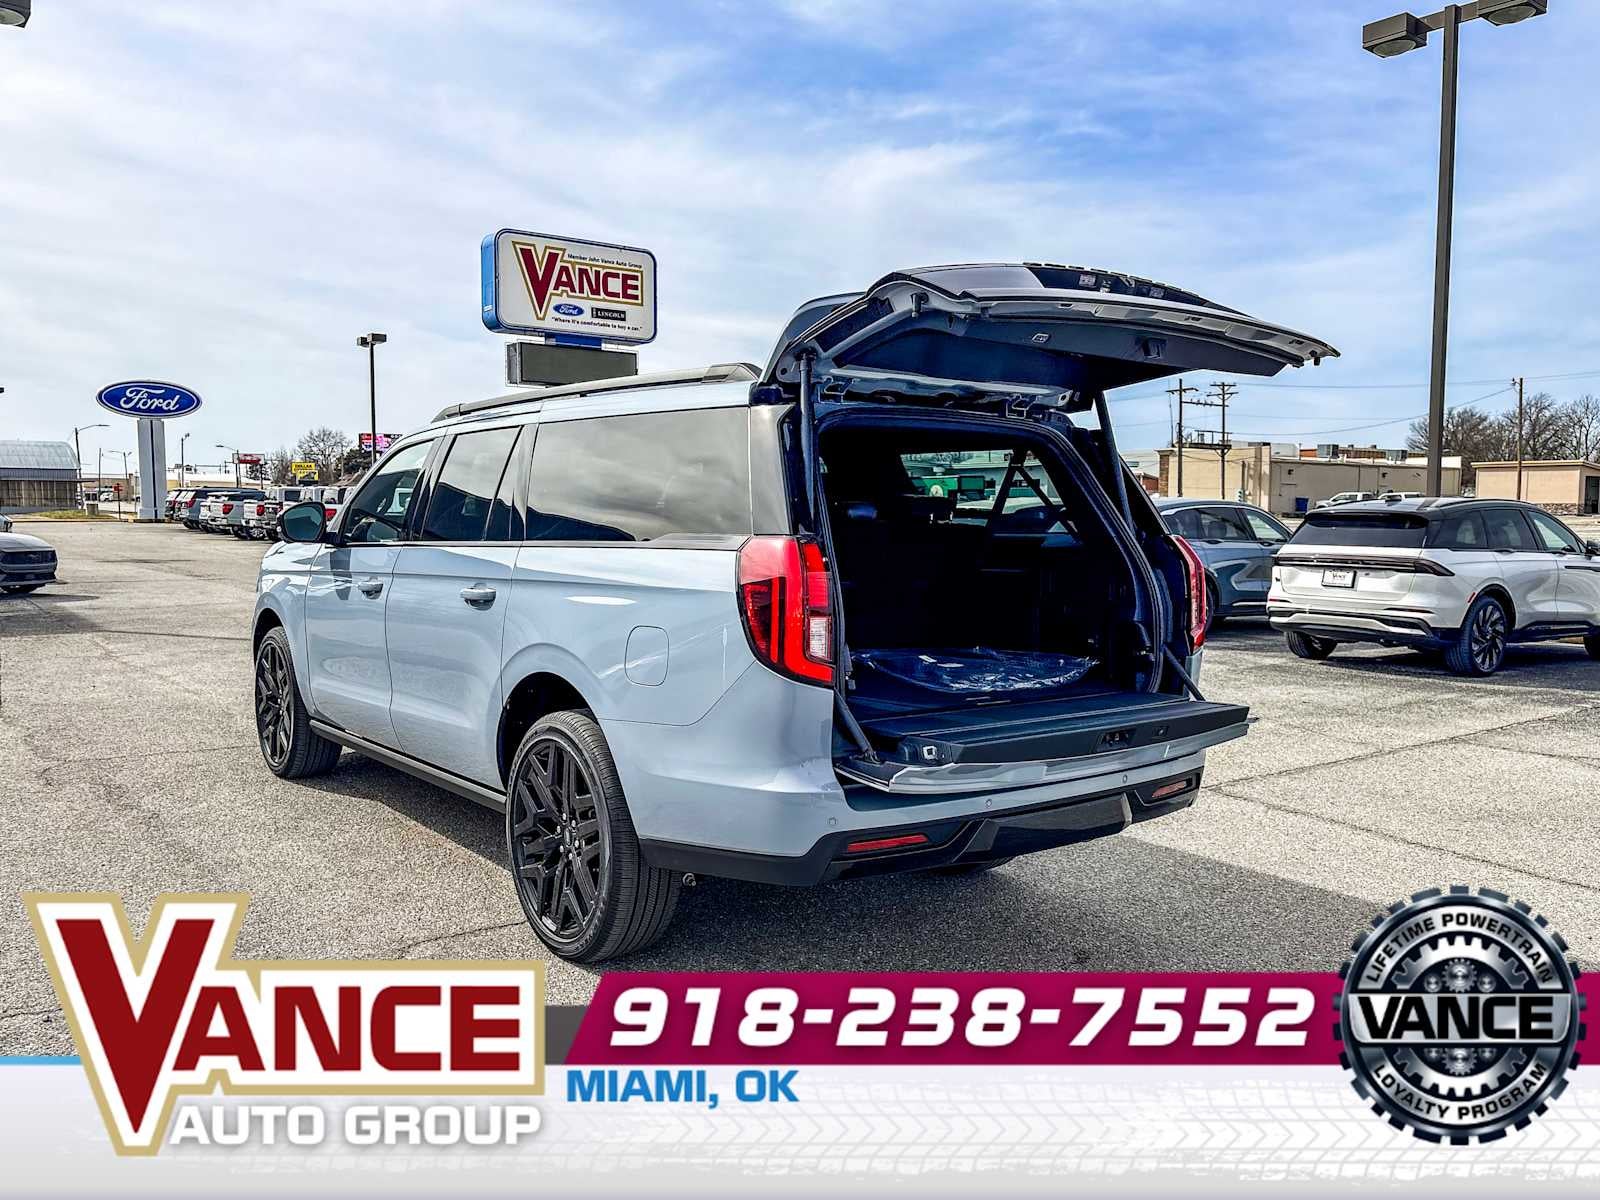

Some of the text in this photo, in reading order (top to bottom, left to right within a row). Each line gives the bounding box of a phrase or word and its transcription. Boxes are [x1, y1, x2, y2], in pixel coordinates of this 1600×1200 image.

[567, 253, 588, 261] Member
[600, 257, 615, 265] Vance
[615, 259, 627, 267] Auto
[627, 261, 642, 270] Group
[518, 246, 640, 316] VANCE
[559, 304, 579, 315] Ford
[597, 310, 625, 319] LINCOLN
[119, 386, 181, 411] Ford
